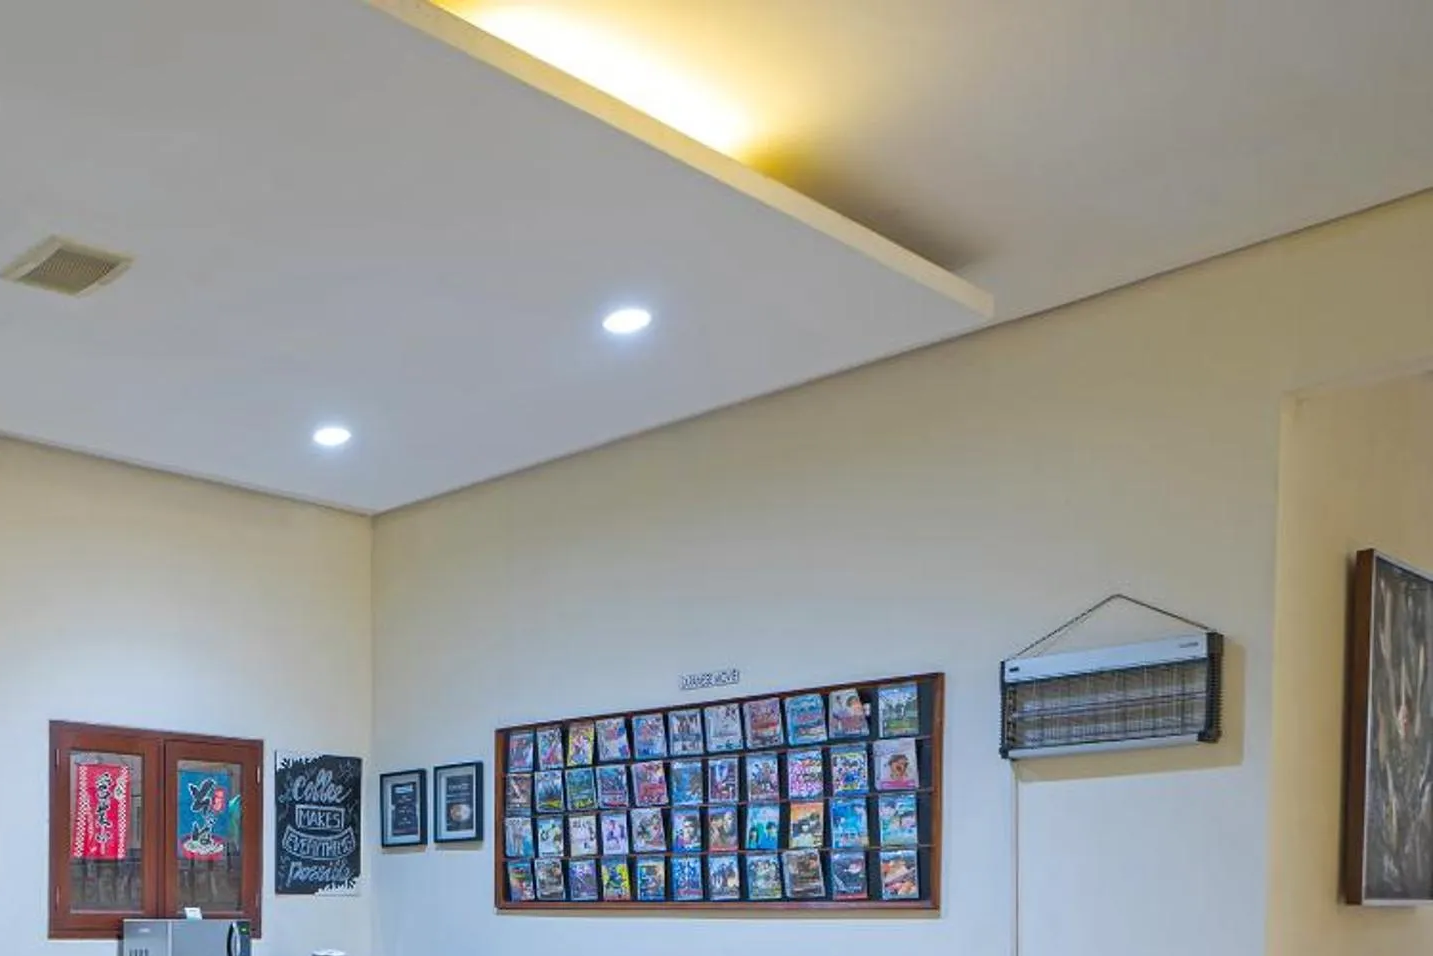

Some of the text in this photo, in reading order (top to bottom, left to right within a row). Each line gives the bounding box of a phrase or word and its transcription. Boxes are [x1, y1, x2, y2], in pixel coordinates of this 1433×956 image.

[292, 769, 352, 803] Coffee
[299, 810, 340, 828] MAKES
[286, 832, 352, 857] EVERYTHING
